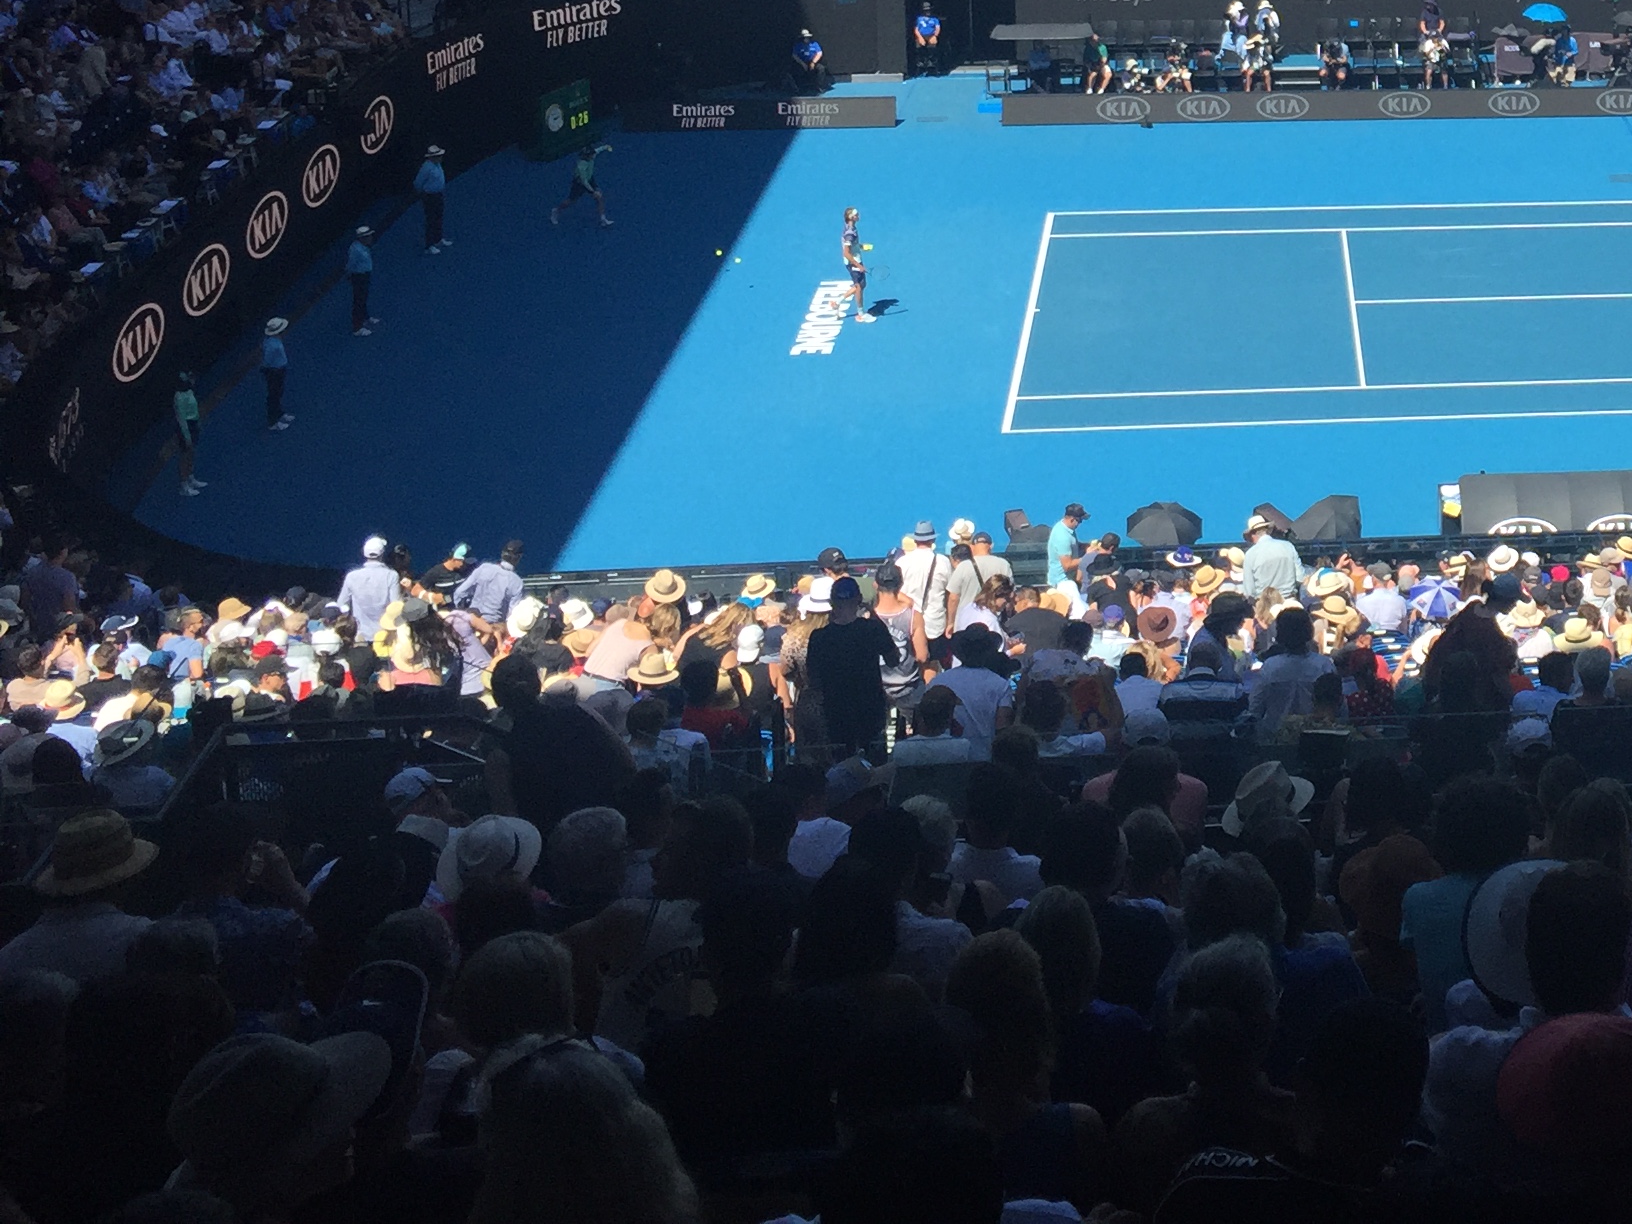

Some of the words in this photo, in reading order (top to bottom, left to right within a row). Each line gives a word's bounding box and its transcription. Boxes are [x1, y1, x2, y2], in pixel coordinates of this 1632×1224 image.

[547, 28, 565, 48] FLY
[568, 19, 608, 44] BETTER
[426, 33, 484, 75] Emirates
[436, 70, 447, 92] FLY
[449, 57, 477, 86] BETTER
[672, 104, 735, 117] Emirates
[777, 102, 839, 114] Emirates
[1106, 102, 1142, 116] KIA
[1186, 101, 1222, 114] KIA
[1265, 100, 1301, 113] KIA
[1387, 97, 1422, 112] KIA
[1497, 96, 1532, 110] KIA
[570, 111, 589, 130] 0:26
[681, 118, 695, 128] FLY
[697, 117, 725, 127] BETTER
[786, 116, 800, 126] FLY
[802, 115, 830, 125] BETTER
[309, 155, 335, 199] KIA
[253, 202, 282, 250] KIA
[190, 255, 224, 307] KIA
[121, 315, 157, 372] KIA
